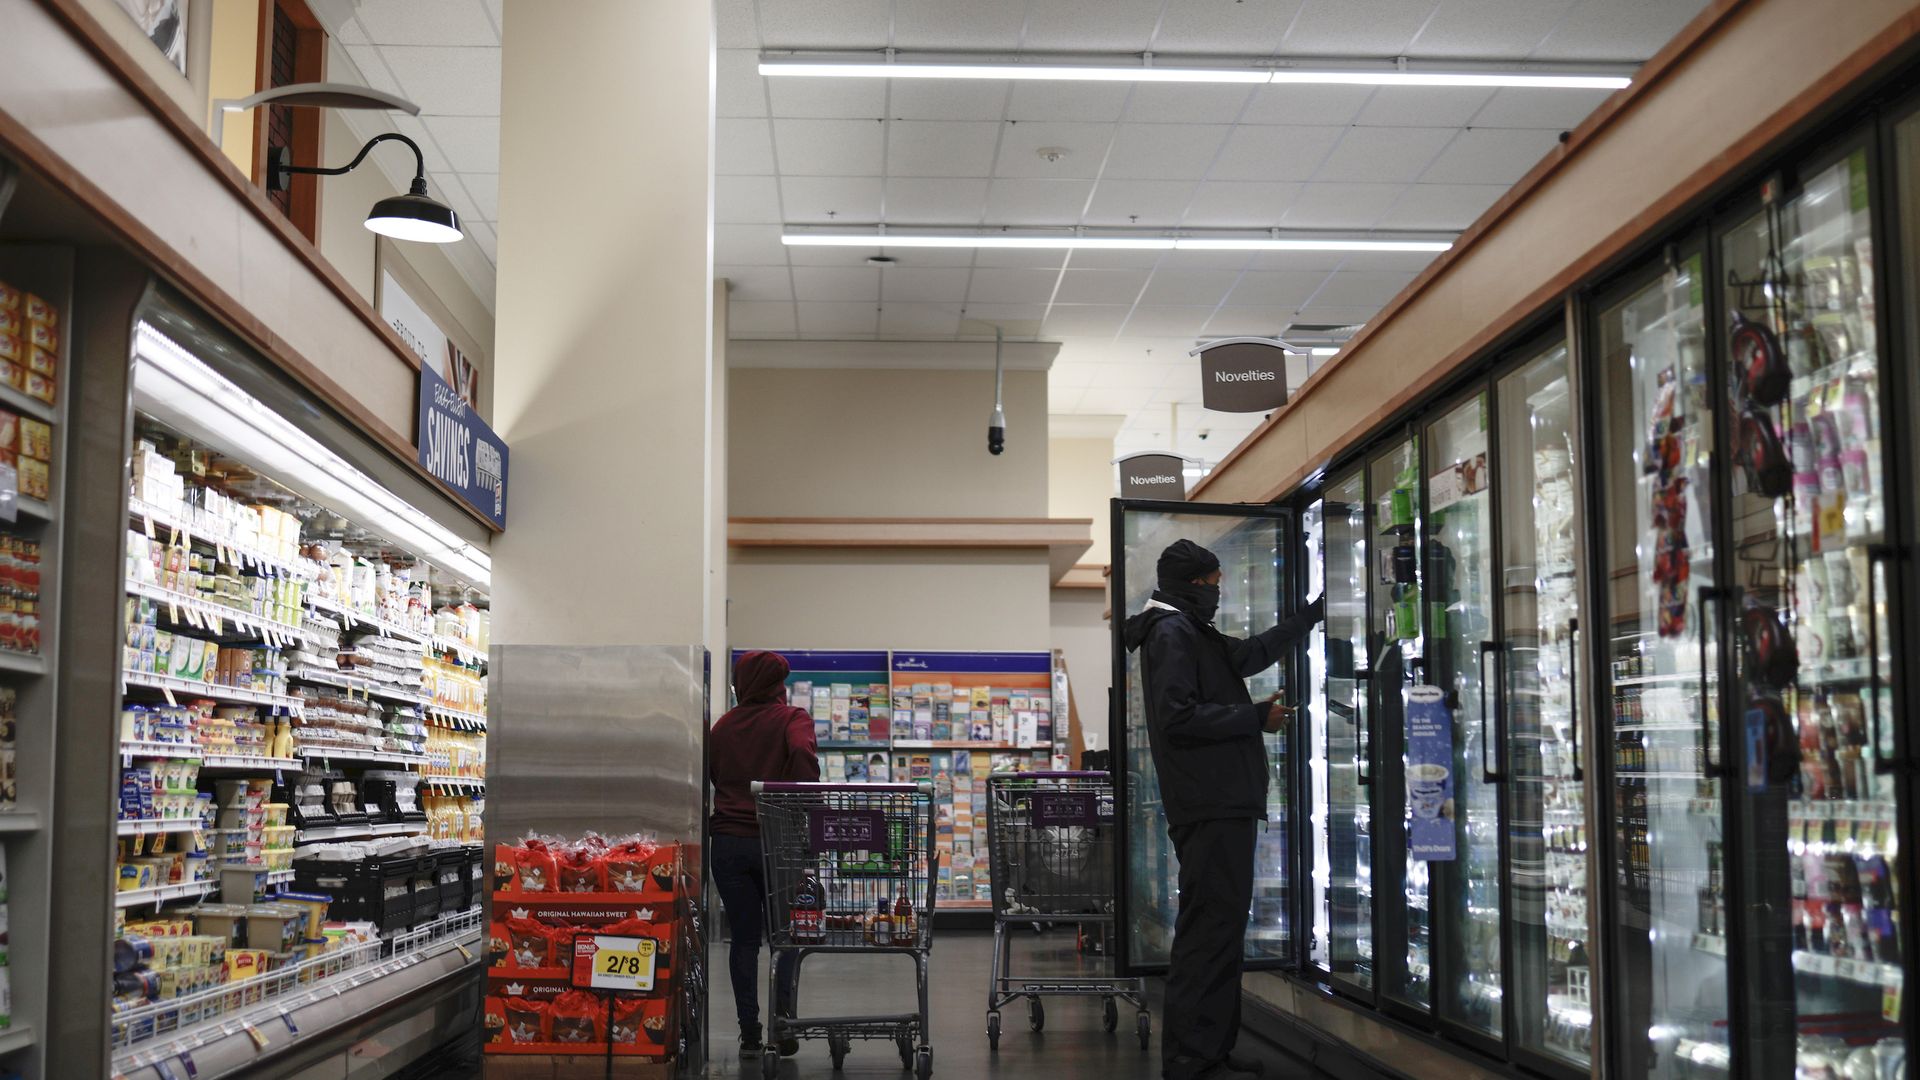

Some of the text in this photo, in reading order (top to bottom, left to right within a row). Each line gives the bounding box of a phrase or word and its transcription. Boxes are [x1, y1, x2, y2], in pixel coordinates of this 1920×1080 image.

[1215, 369, 1276, 383] Novelties
[426, 406, 471, 491] SAVINGS
[1130, 474, 1177, 486] Novelties
[537, 910, 570, 918] ORIGINAL
[532, 986, 566, 994] ORIGINAL
